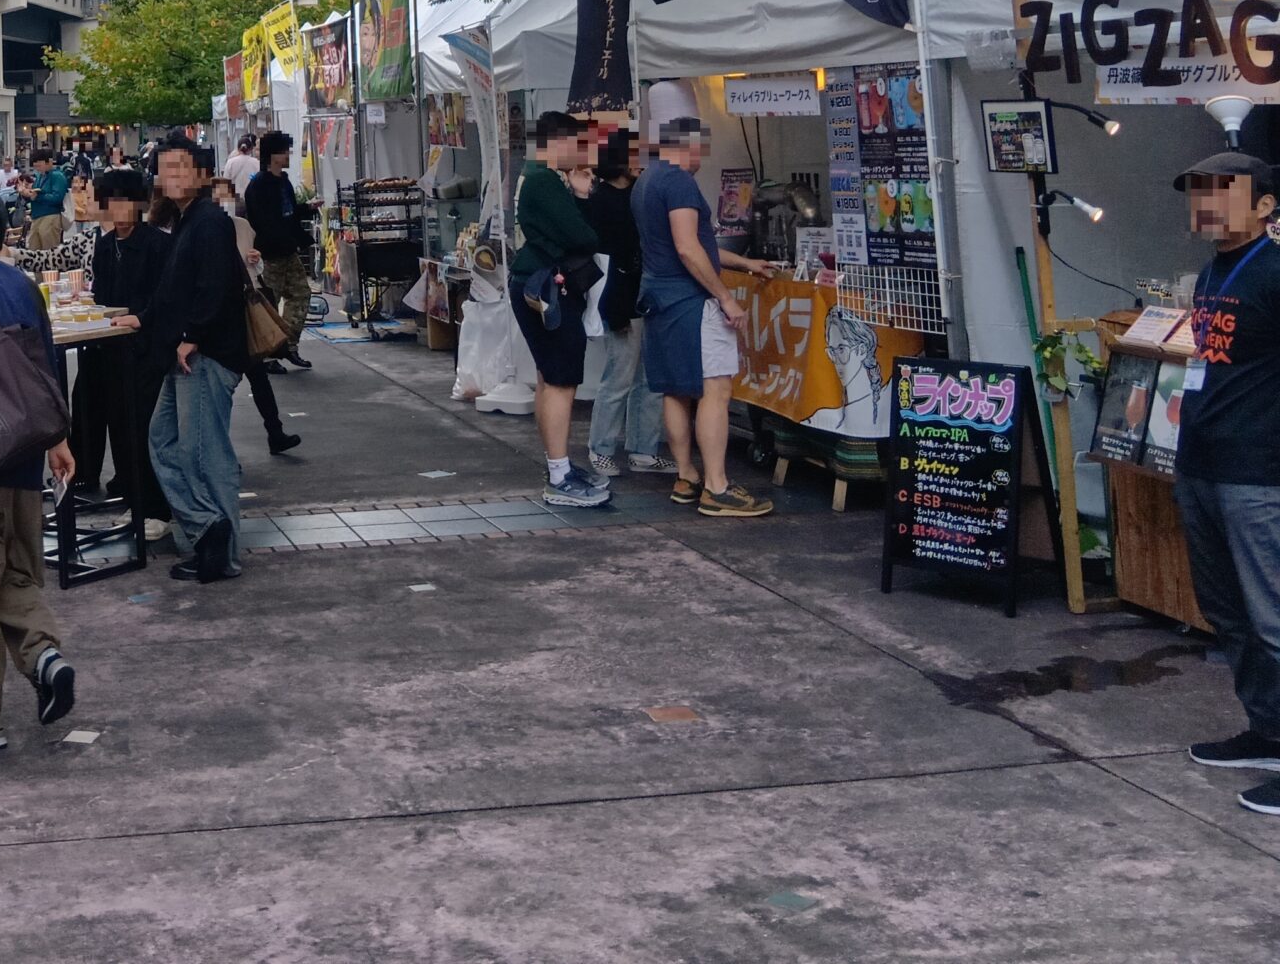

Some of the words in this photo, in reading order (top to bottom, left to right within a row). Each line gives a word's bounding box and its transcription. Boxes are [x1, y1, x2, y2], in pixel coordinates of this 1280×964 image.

[730, 89, 811, 103] ディレイラブリューワークス
[830, 95, 852, 108] ¥1200
[730, 287, 813, 357] レイラ
[913, 374, 1015, 425] ラインナップ
[913, 493, 941, 508] ESB
